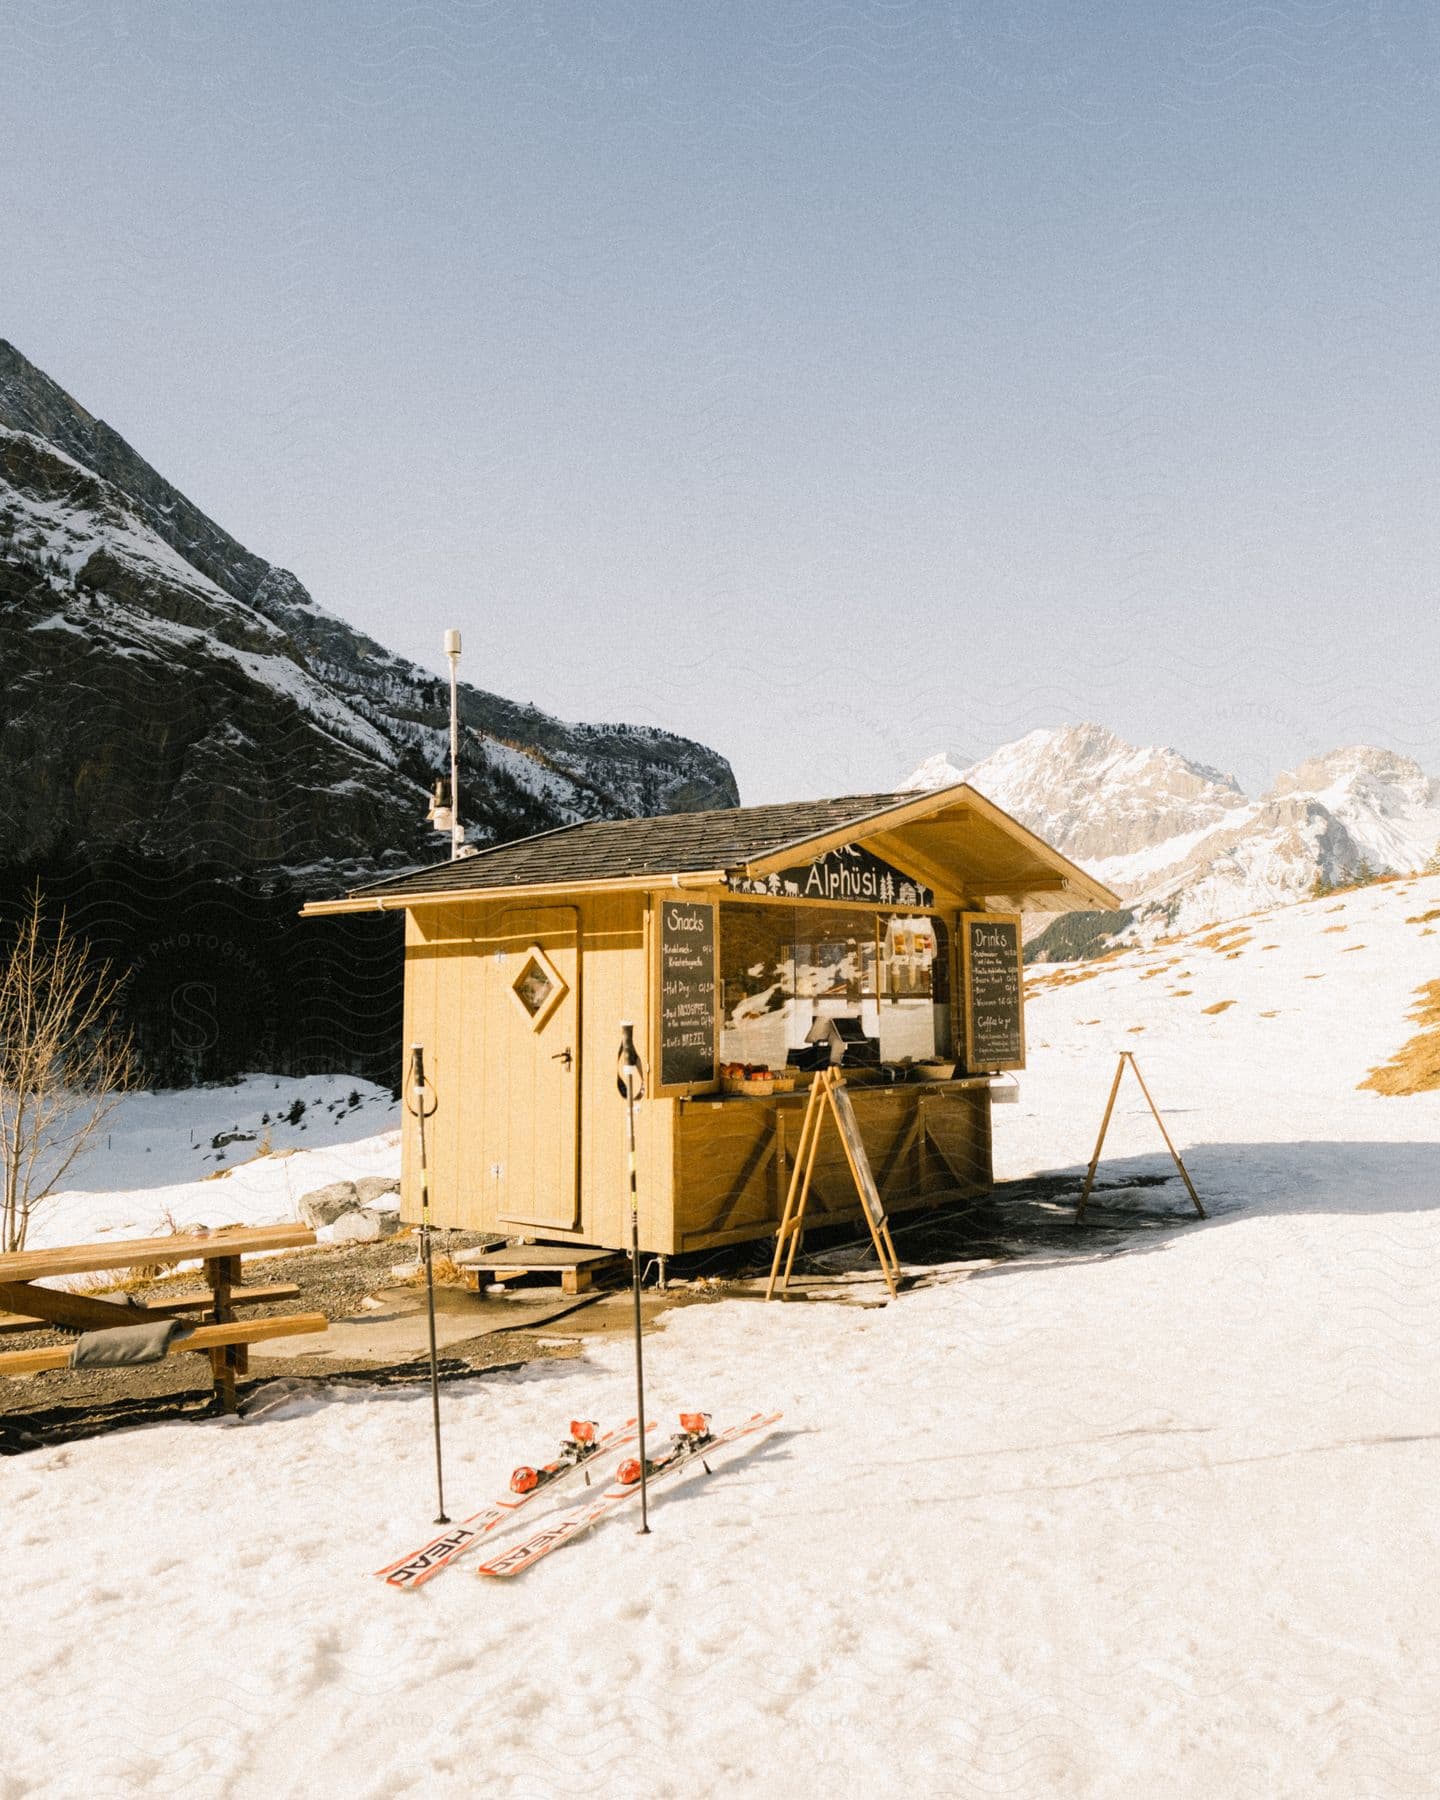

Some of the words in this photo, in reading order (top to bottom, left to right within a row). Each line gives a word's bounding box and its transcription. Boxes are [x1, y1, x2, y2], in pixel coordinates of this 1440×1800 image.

[804, 862, 877, 900] Alphüsi
[667, 908, 704, 932] Snacks
[975, 928, 1008, 947] Drinks
[387, 1529, 475, 1582] HEAD
